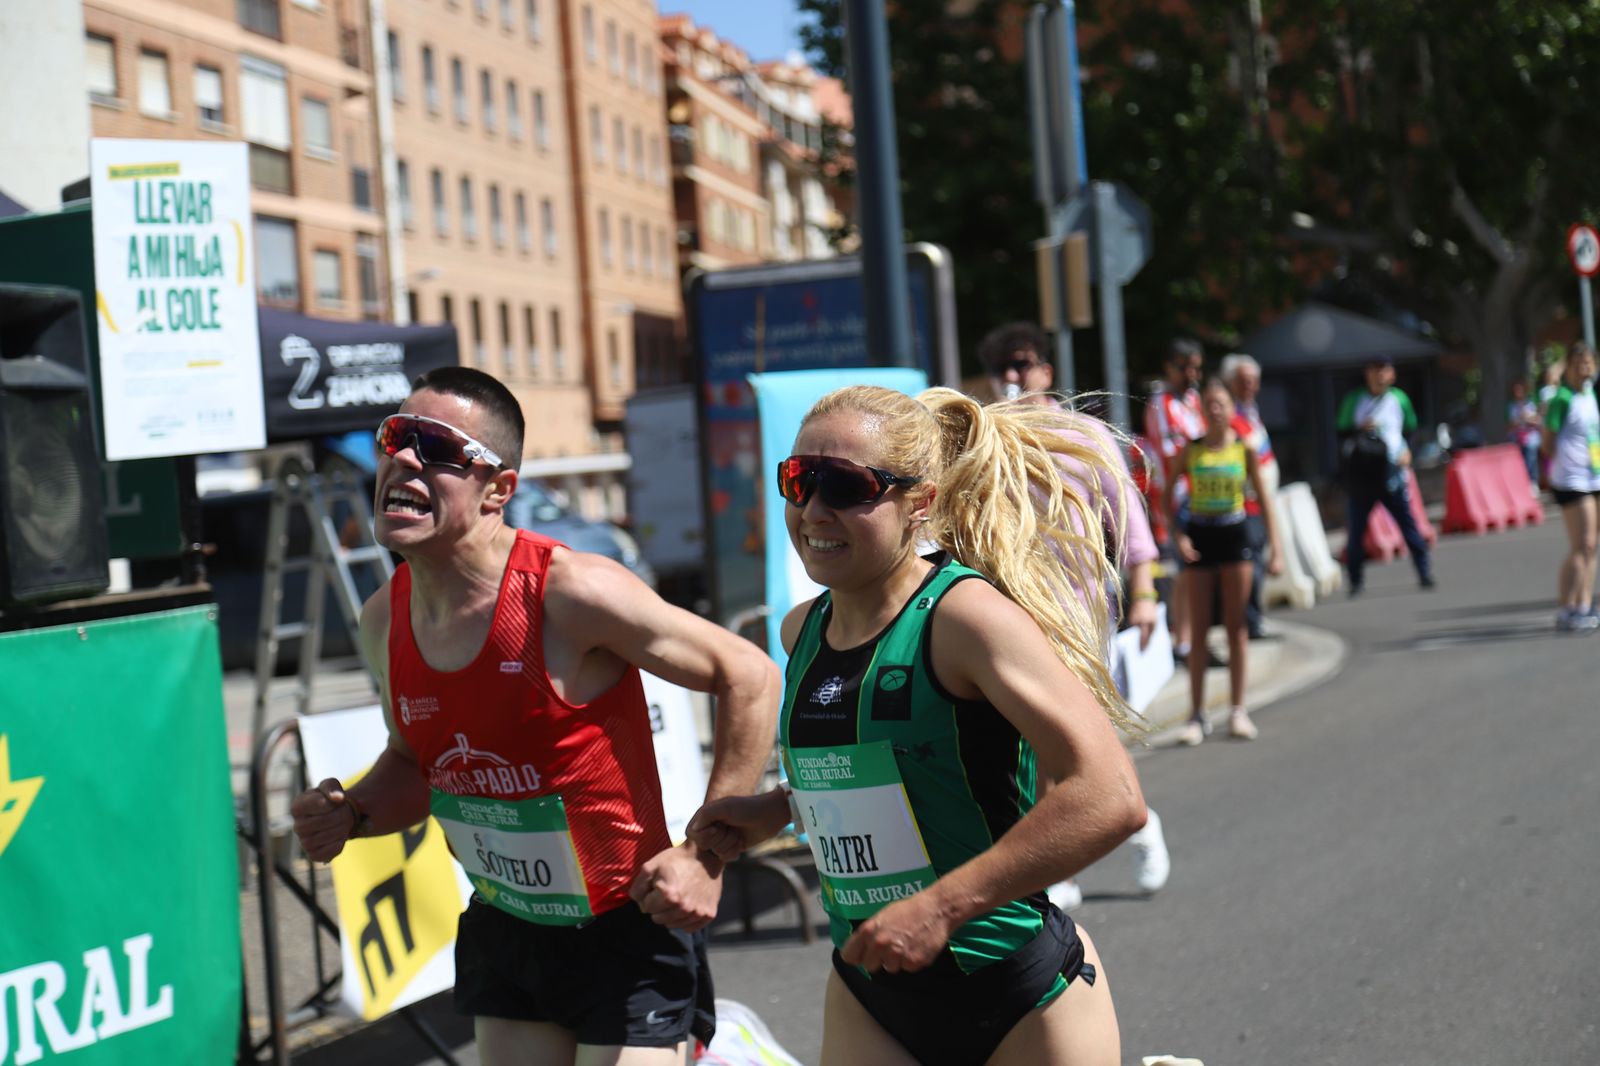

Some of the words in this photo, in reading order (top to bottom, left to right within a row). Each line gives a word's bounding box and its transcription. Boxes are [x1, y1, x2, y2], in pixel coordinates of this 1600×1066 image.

[134, 182, 212, 223] LLEVAR
[128, 235, 141, 278] A
[146, 235, 170, 278] MI
[175, 235, 223, 278] HIJA
[167, 288, 221, 331] COLE
[473, 764, 541, 795] PABLO
[822, 768, 854, 779] RURAL
[809, 805, 817, 827] 3
[473, 832, 483, 848] 6
[819, 834, 879, 874] PATRI
[476, 848, 553, 888] SOTELO
[530, 902, 585, 918] RURAL
[834, 888, 867, 906] CAJA
